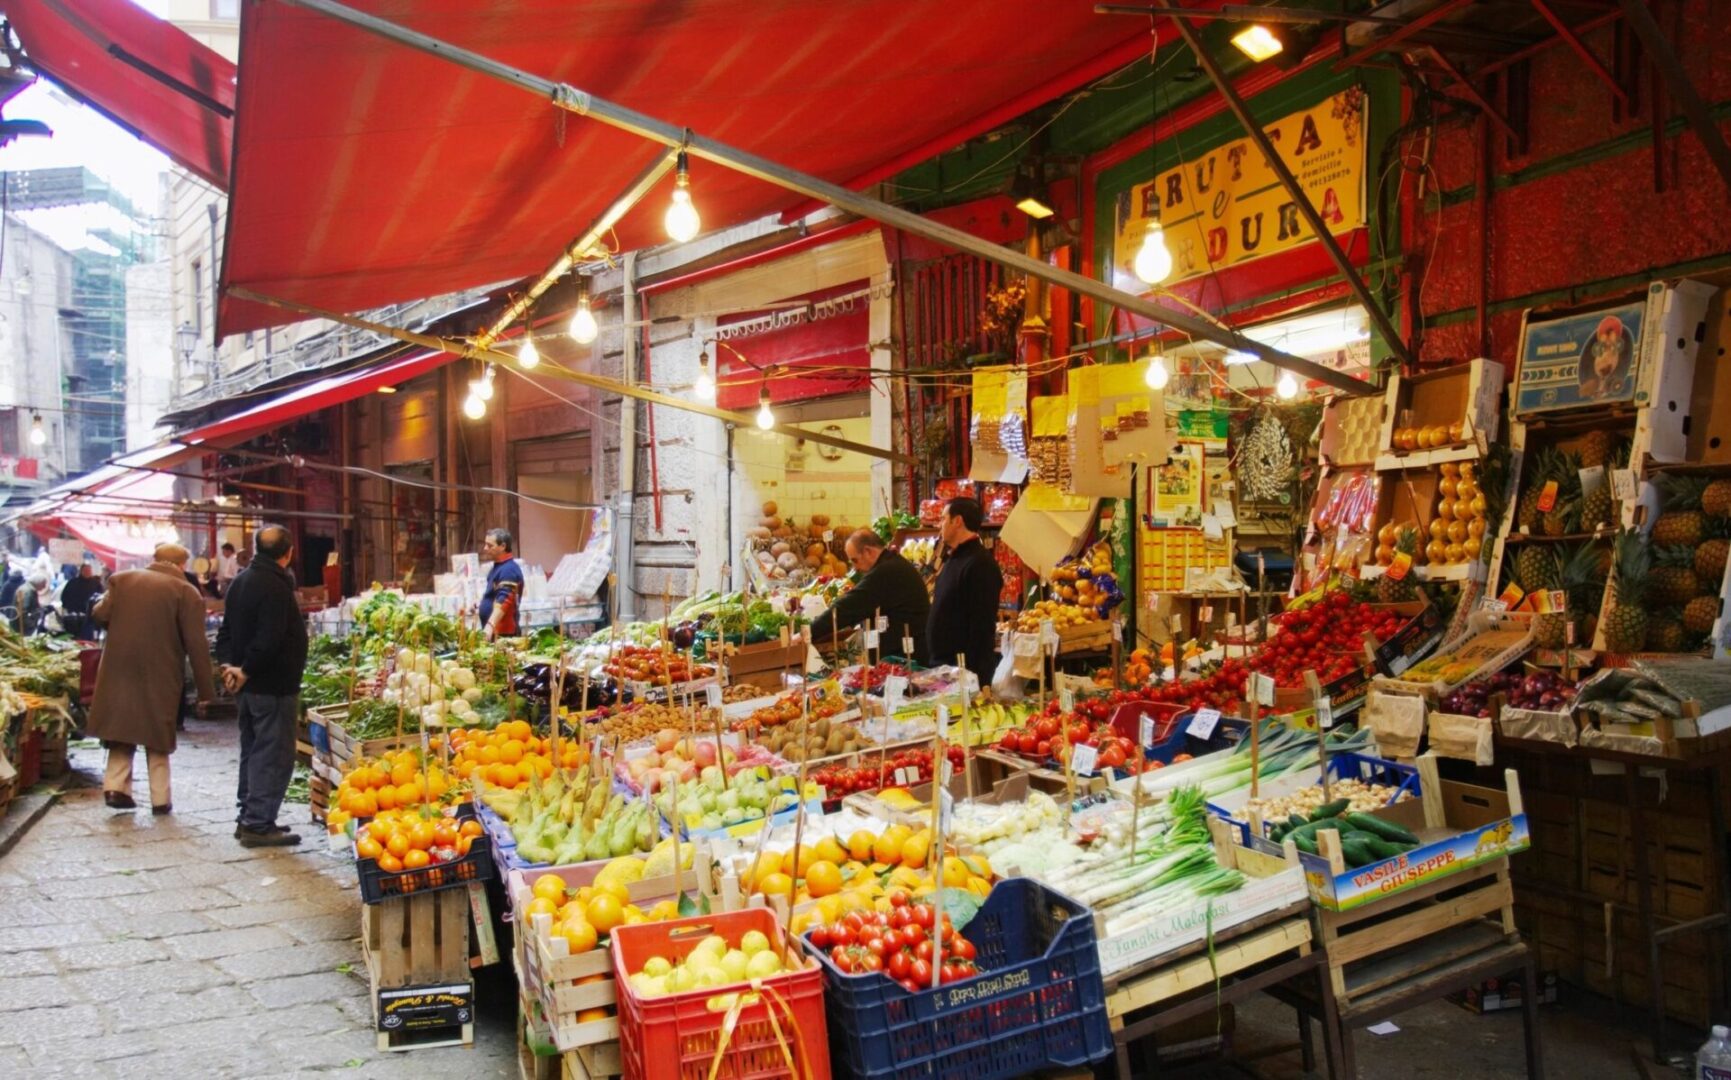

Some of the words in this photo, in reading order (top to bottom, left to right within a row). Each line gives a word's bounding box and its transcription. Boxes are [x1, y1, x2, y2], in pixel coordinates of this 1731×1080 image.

[1212, 189, 1231, 220] e
[1353, 855, 1408, 889] VASILE
[1380, 849, 1456, 893] GIUSEPPE
[1163, 902, 1231, 938] Malaasi
